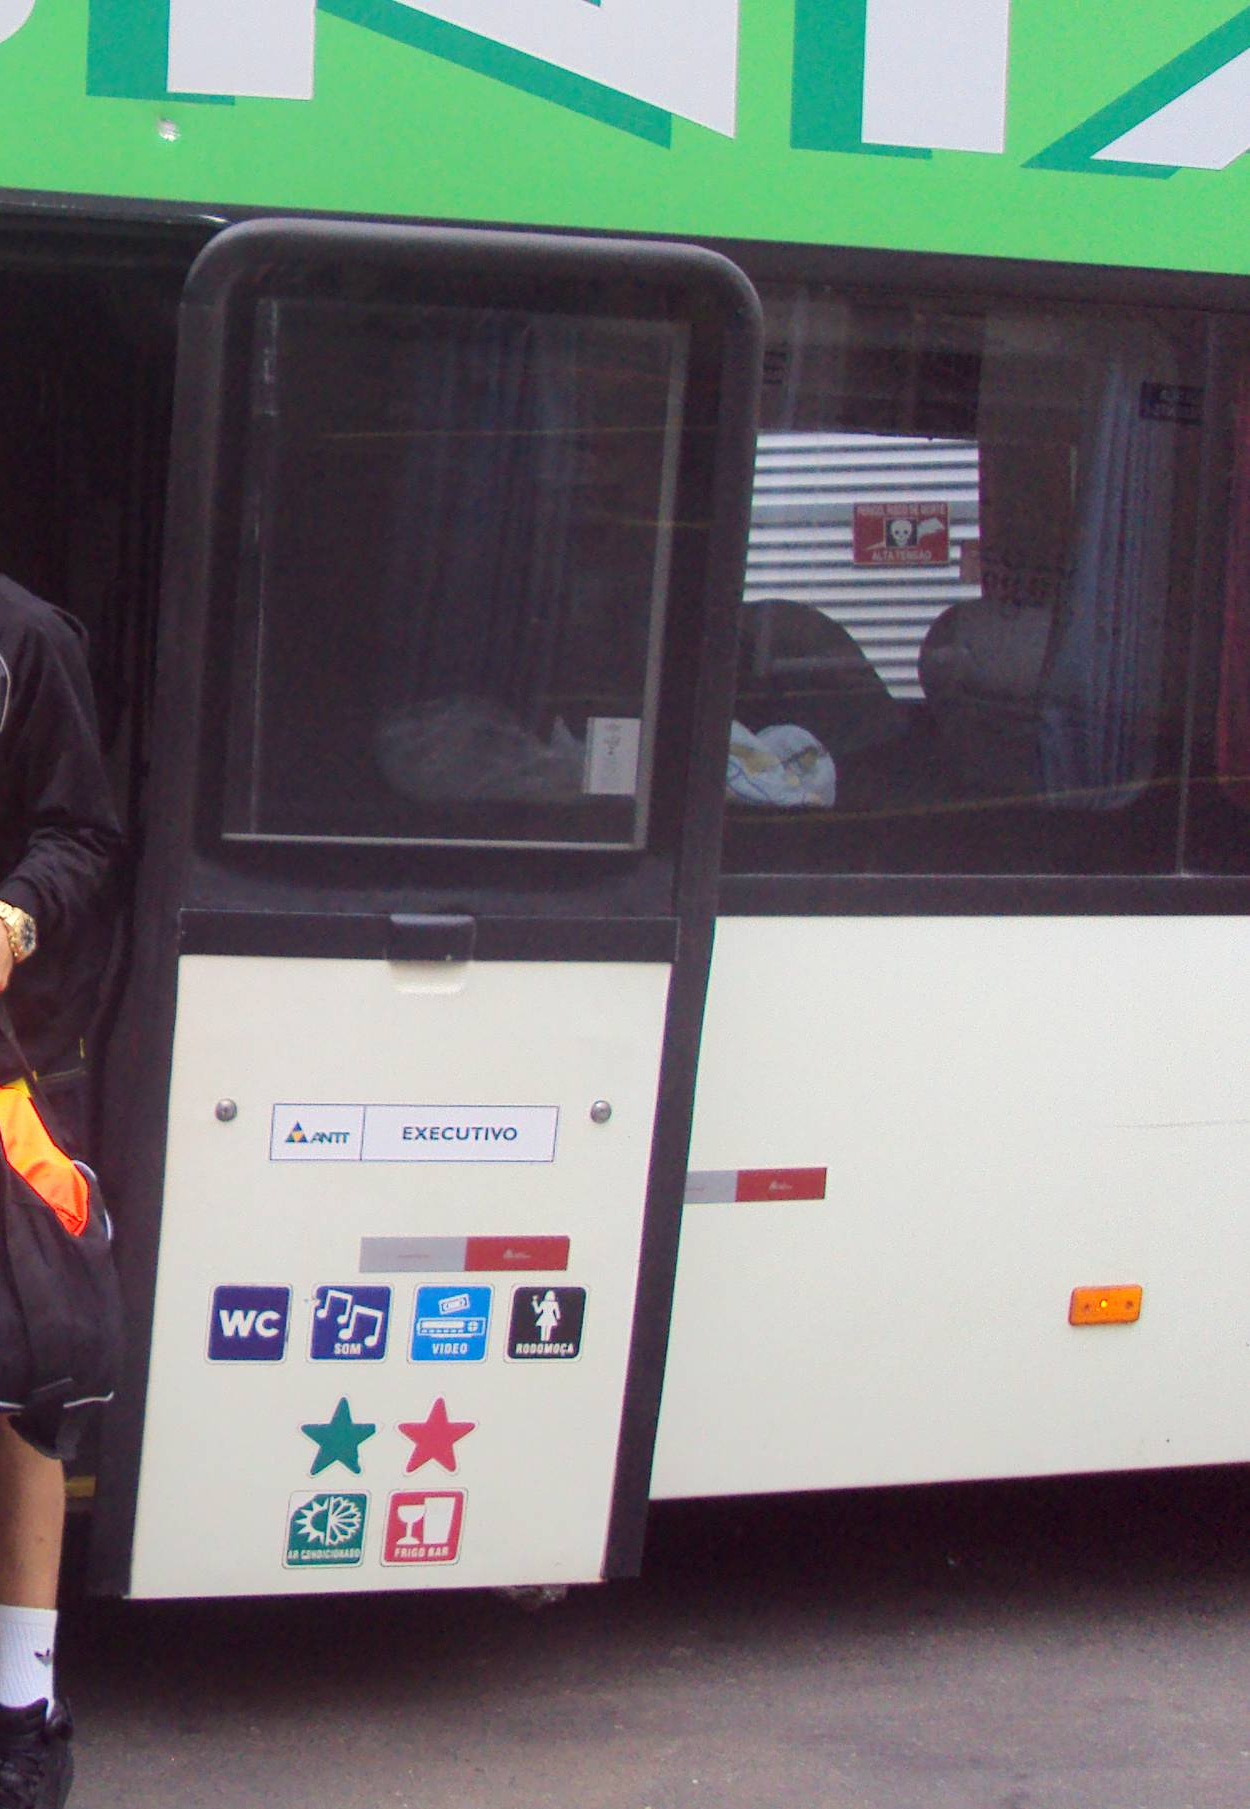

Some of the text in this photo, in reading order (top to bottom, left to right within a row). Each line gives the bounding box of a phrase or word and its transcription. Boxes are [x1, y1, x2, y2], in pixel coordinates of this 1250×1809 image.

[310, 1131, 350, 1144] ANTT
[402, 1126, 518, 1141] EXECUTIVO
[219, 1309, 281, 1338] WC
[334, 1342, 361, 1354] SOM
[287, 1549, 299, 1559] AR
[395, 1547, 449, 1558] FRIGO BAR
